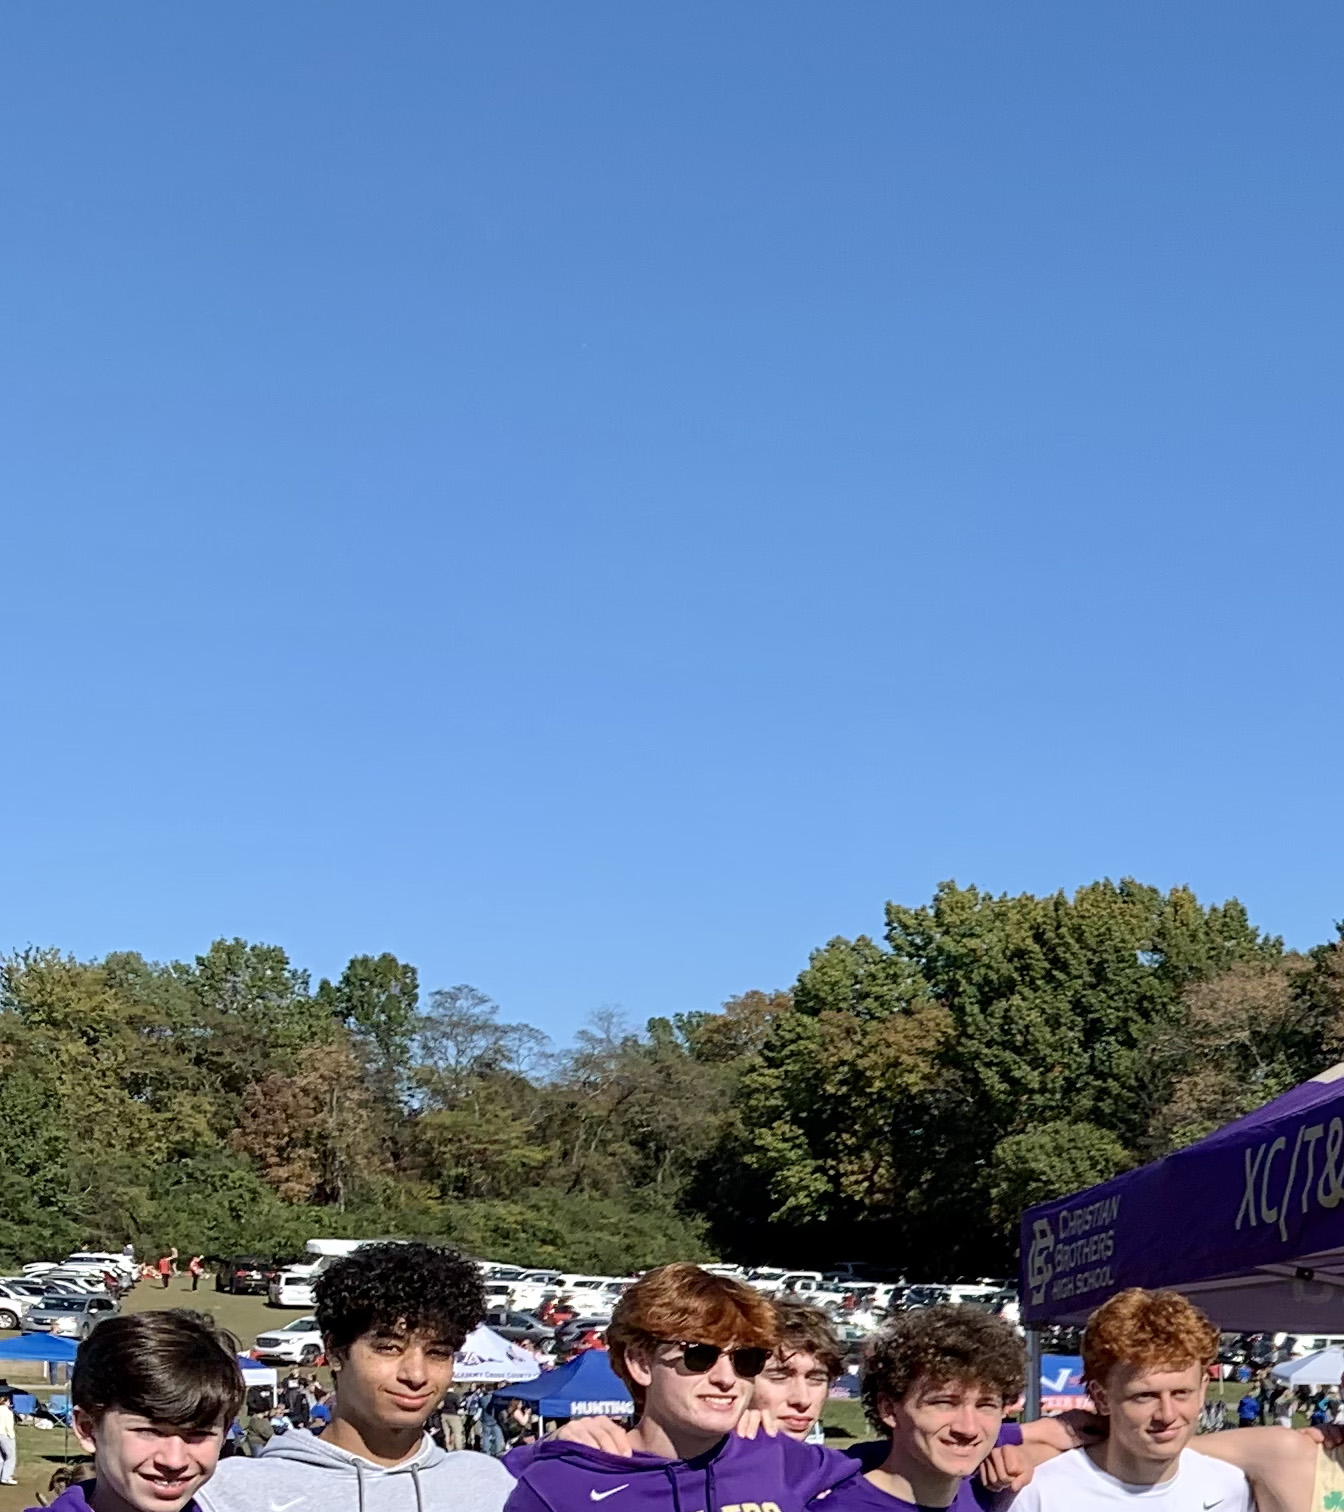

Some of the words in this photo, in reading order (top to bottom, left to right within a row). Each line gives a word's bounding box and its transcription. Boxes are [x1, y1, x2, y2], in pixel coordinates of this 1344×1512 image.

[1059, 1194, 1121, 1238] CHRISTIAN
[1054, 1230, 1115, 1272] BROTHERS
[1075, 1265, 1115, 1294] SCHOOL
